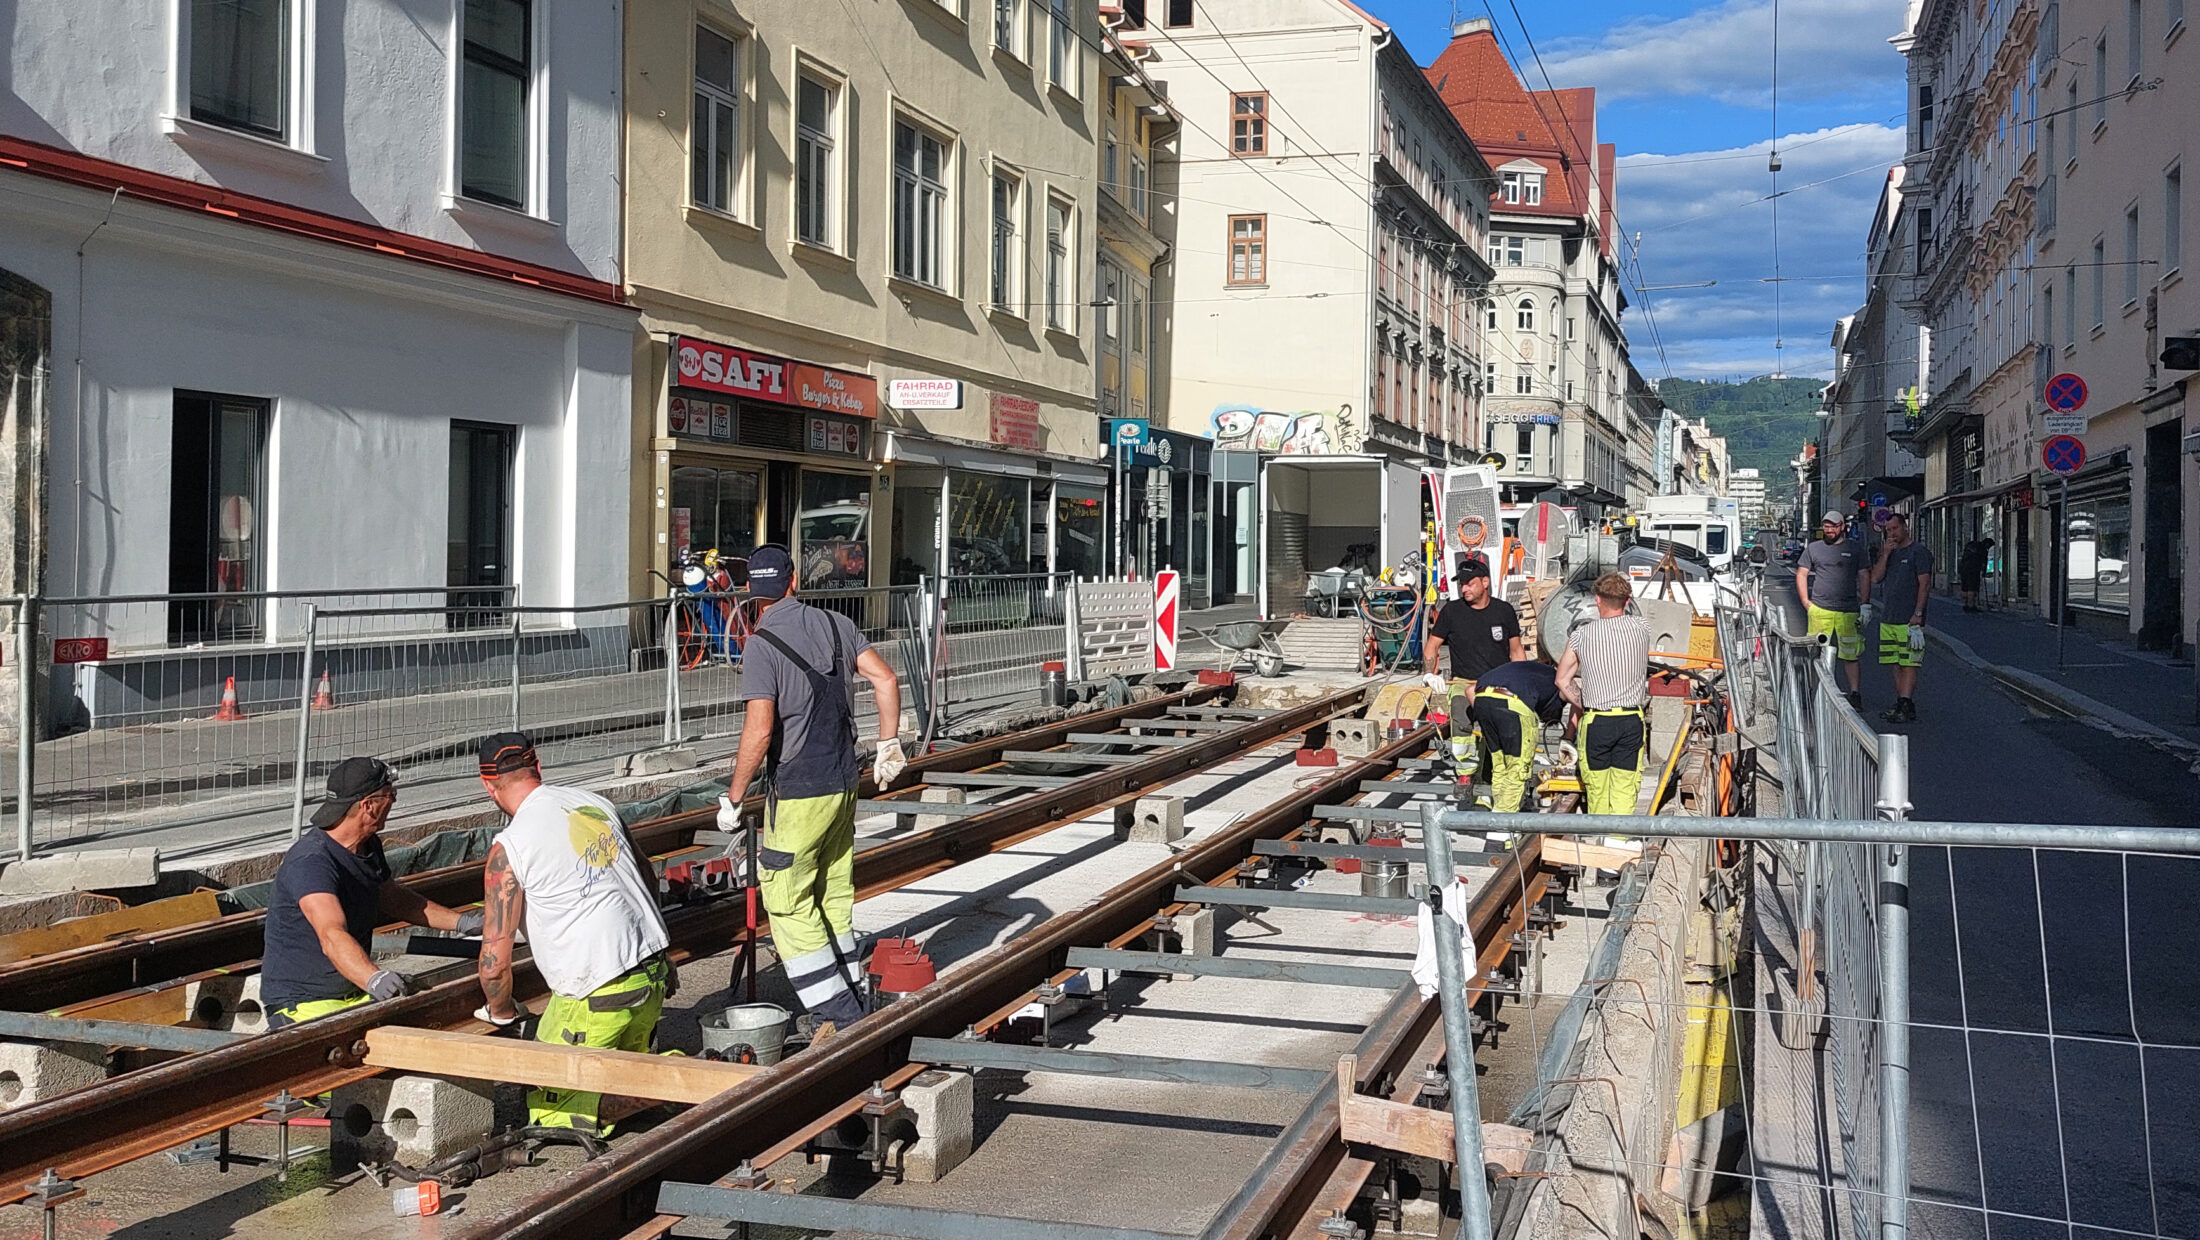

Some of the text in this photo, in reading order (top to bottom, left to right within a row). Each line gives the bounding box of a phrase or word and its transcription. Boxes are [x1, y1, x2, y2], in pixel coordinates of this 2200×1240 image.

[701, 351, 783, 394] SAFI
[823, 371, 845, 391] Pizza
[896, 381, 953, 390] FAHRRAD
[802, 383, 831, 408] Burger
[840, 392, 864, 415] Kebap
[715, 415, 728, 426] Ice
[714, 426, 728, 436] Tea
[1663, 411, 1671, 494] ANNENHOF
[60, 643, 91, 659] EKRO
